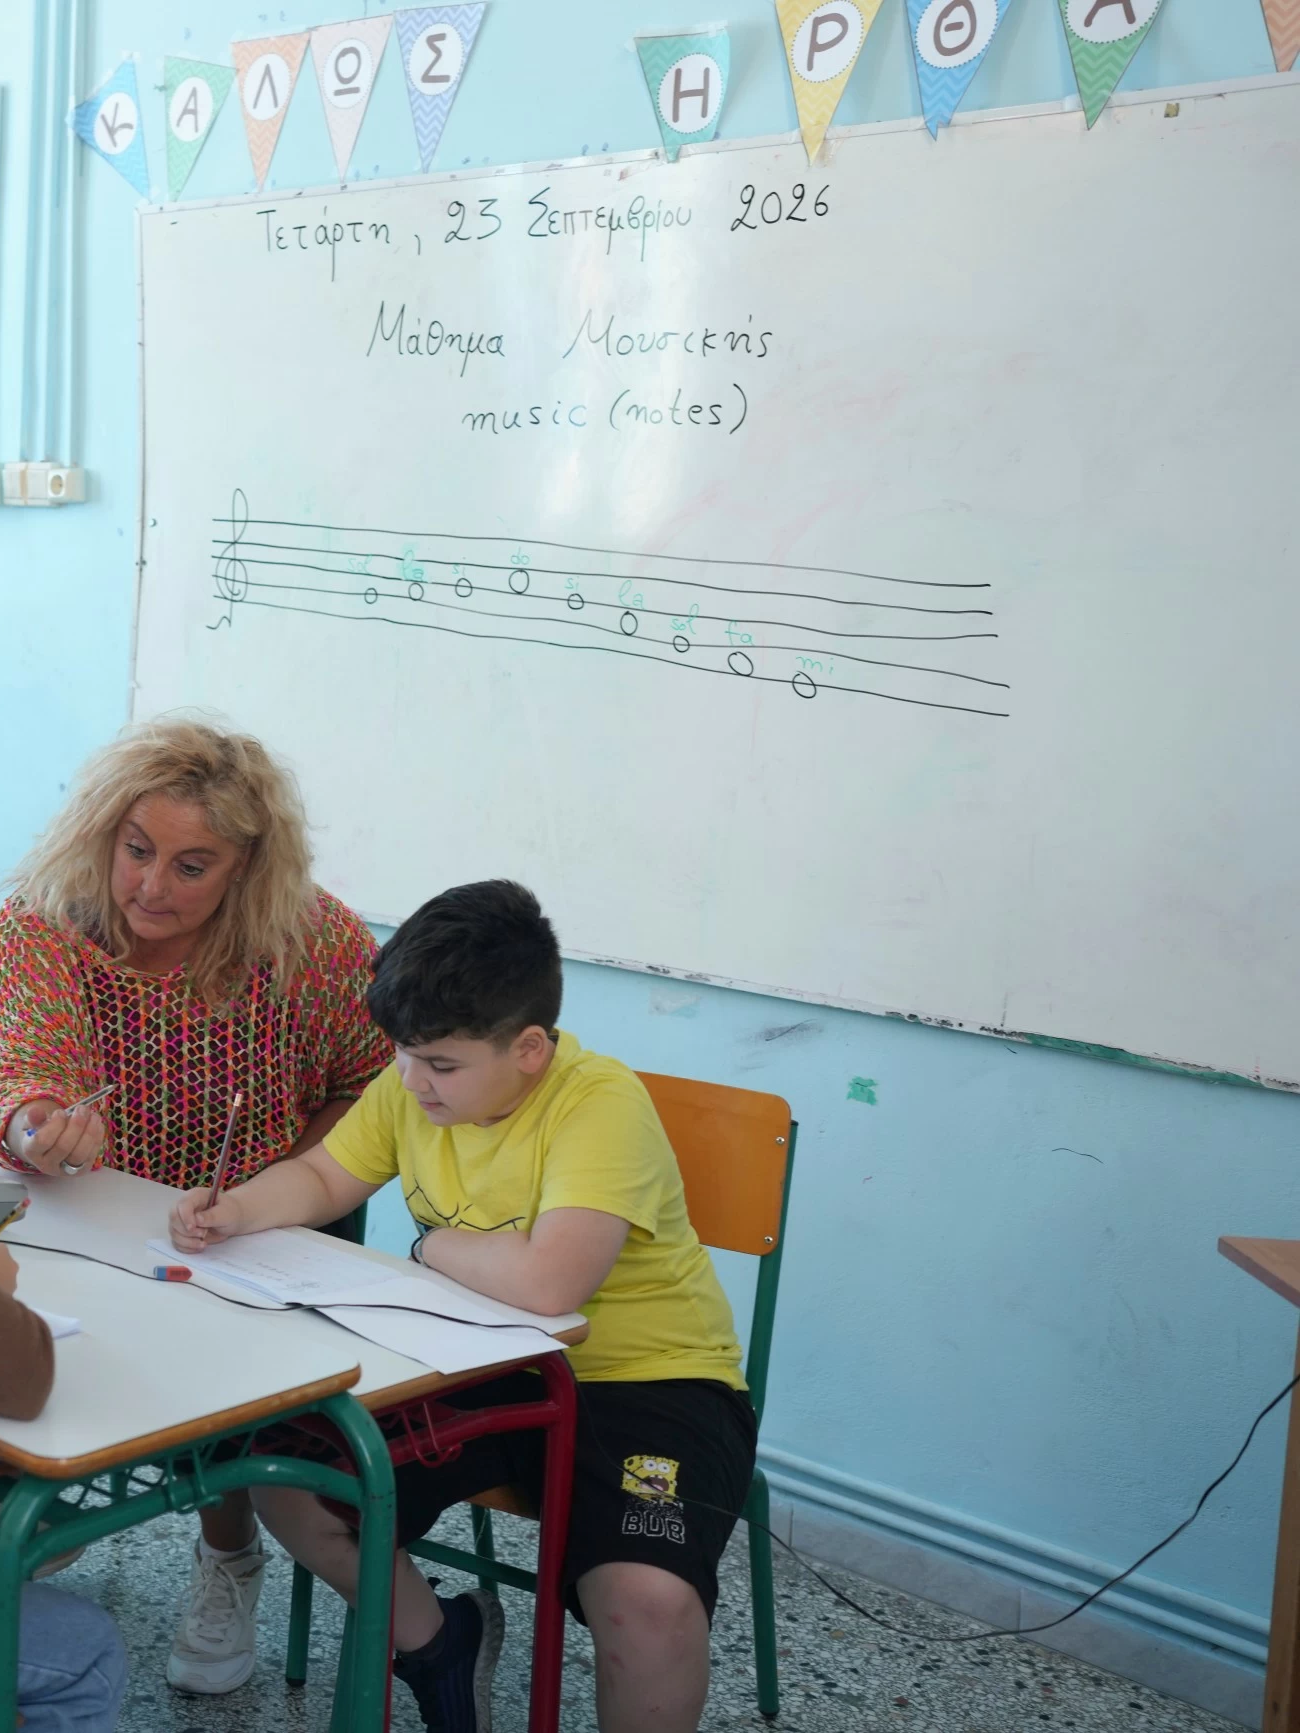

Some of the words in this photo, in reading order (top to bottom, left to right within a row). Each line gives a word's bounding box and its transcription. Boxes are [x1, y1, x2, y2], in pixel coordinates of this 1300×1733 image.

[444, 198, 503, 242] 23
[527, 186, 693, 263] Σεπτεμβρίου
[730, 182, 831, 233] 2026
[366, 300, 505, 378] Μάθημα
[461, 400, 588, 435] music
[609, 382, 748, 435] (notes)
[509, 546, 531, 566] do
[618, 579, 644, 610] la
[670, 603, 700, 635] sol
[724, 619, 756, 647] fa
[795, 656, 836, 676] mi
